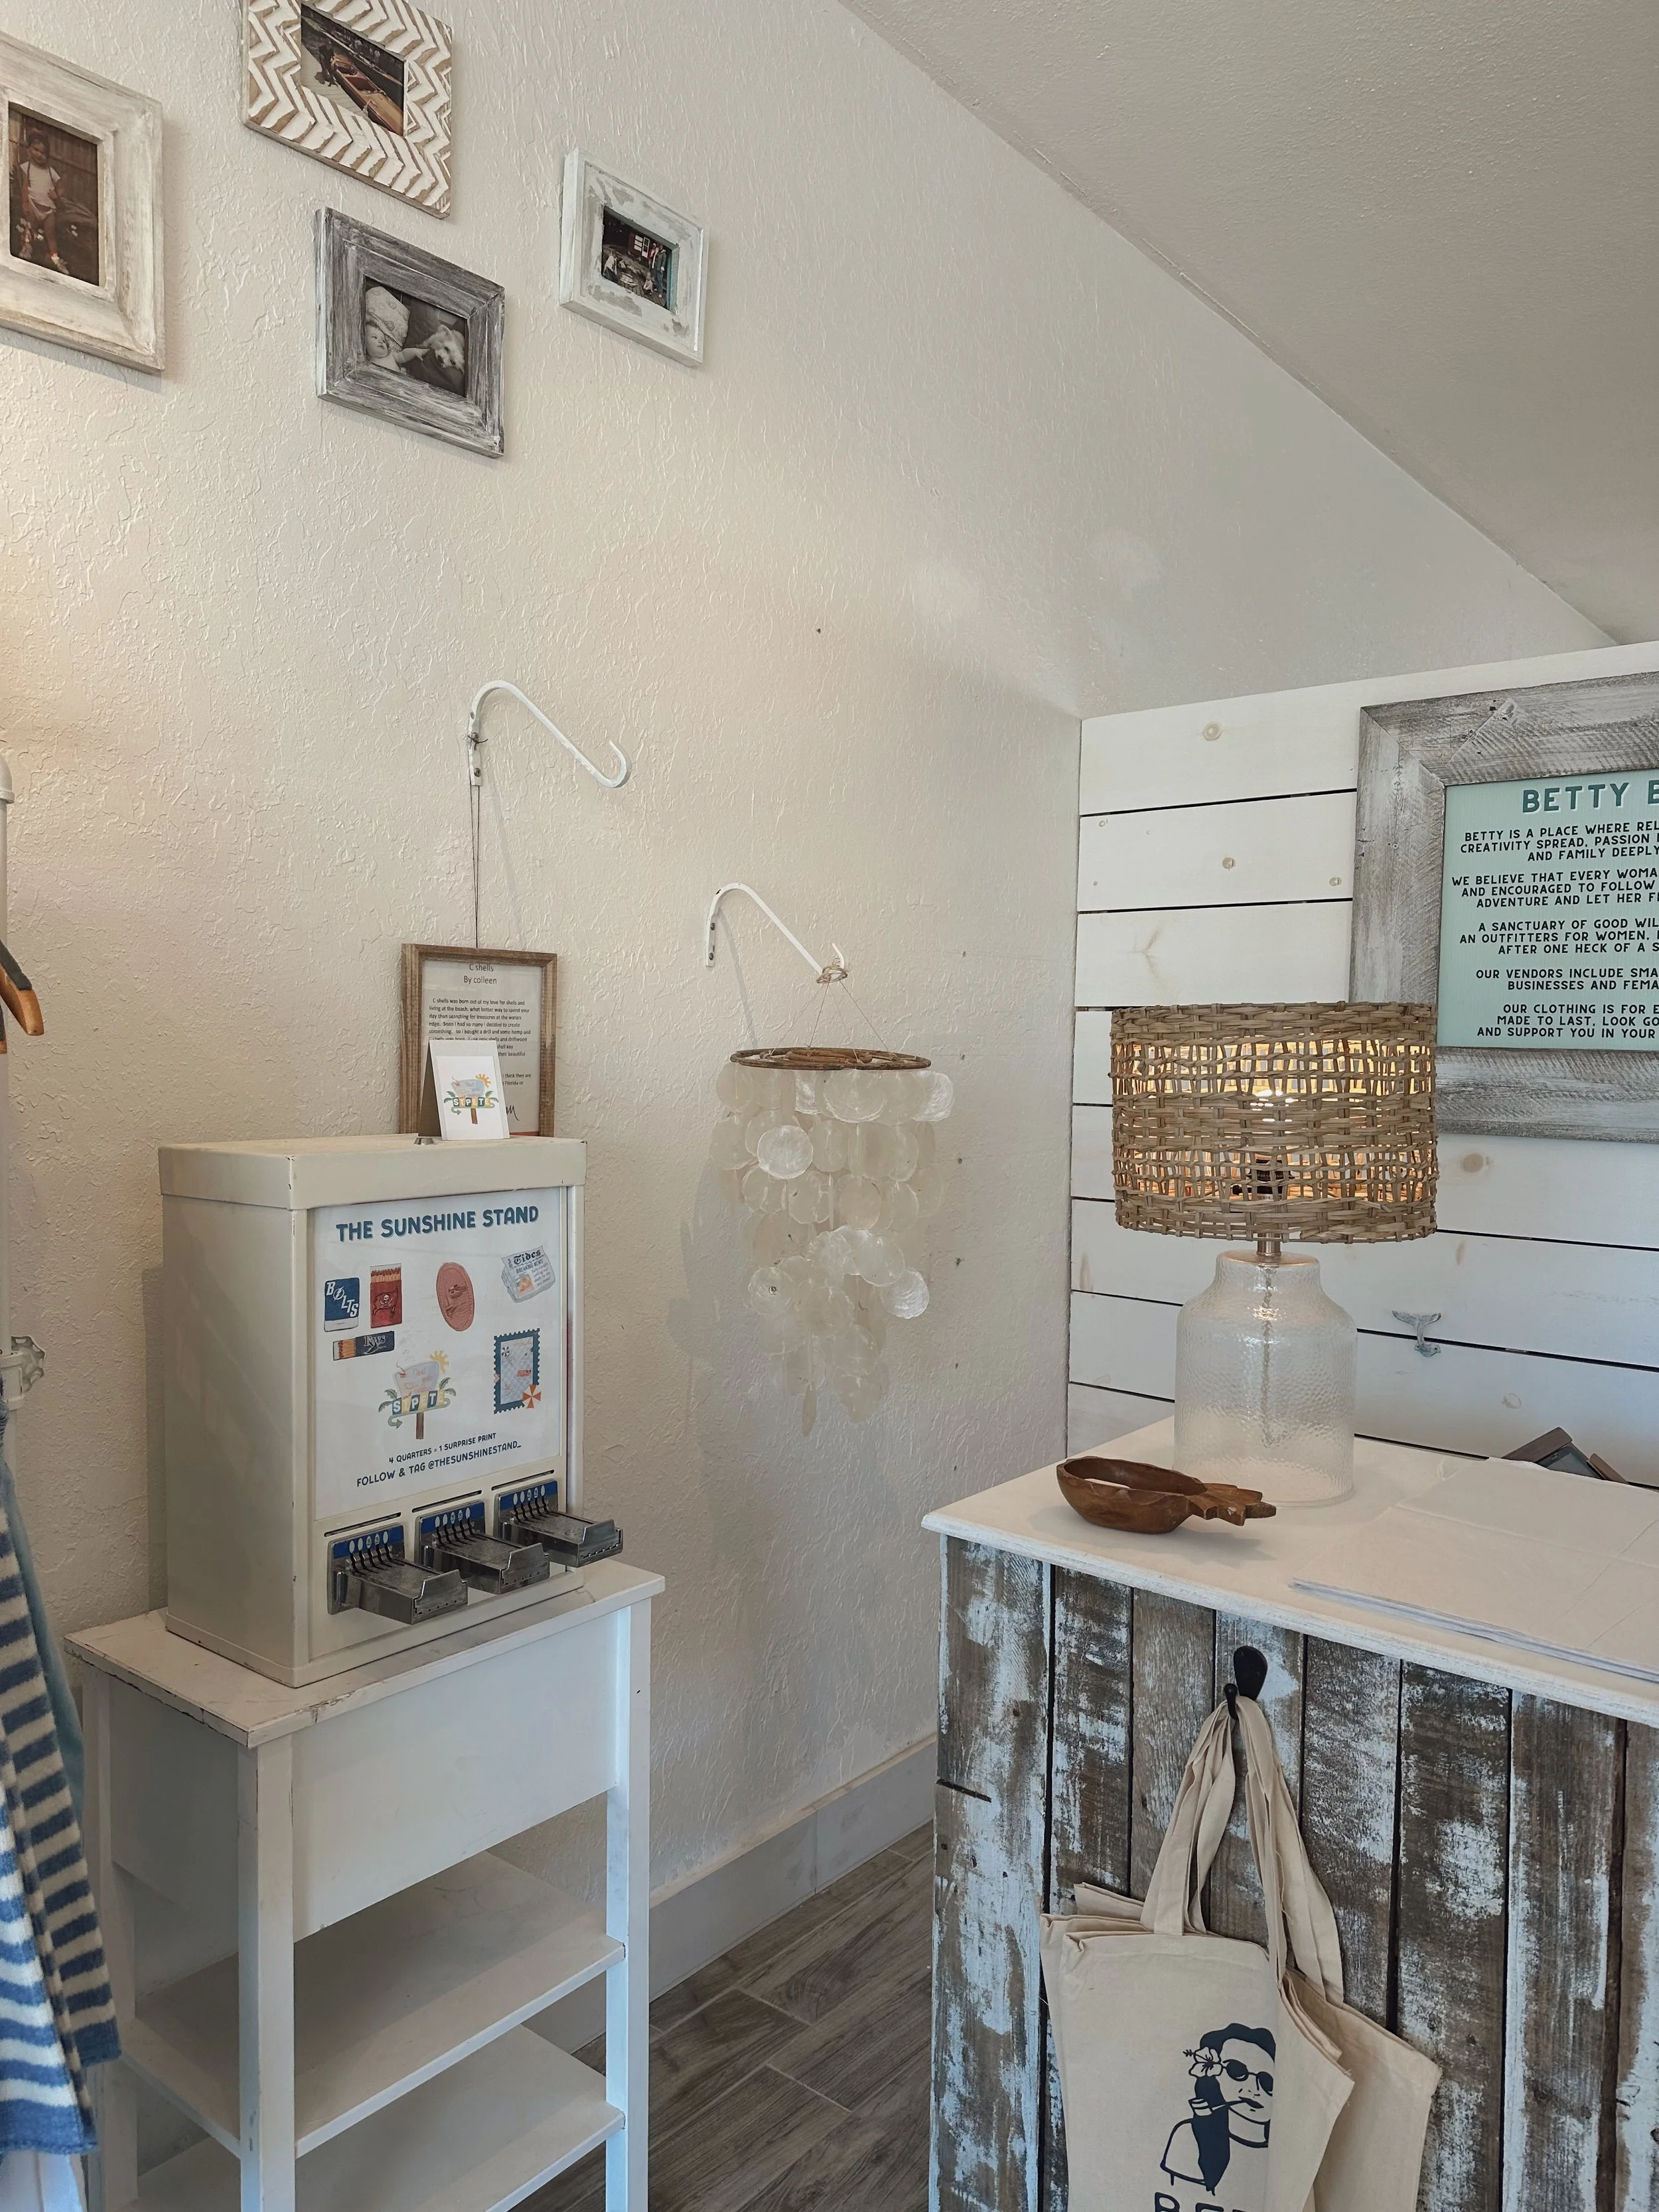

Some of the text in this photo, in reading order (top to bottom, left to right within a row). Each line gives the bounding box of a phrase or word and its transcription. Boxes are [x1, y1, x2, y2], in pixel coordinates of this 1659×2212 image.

[1522, 782, 1629, 813] BETTY
[1465, 830, 1504, 842] BETTY
[1509, 829, 1520, 839] IS
[1526, 828, 1534, 838] A
[1540, 825, 1579, 838] PLACE
[1585, 822, 1630, 835] WHERE
[1460, 840, 1531, 853] CREATIVITY
[1536, 837, 1588, 849] SPREAD,
[1595, 833, 1650, 846] PASSION
[1527, 851, 1553, 861] AND
[1558, 848, 1606, 860] FAMILY
[1451, 876, 1470, 886] WE
[1475, 873, 1524, 885] BELIEVE
[1531, 871, 1563, 883] THAT
[1570, 869, 1611, 881] EVERY
[1461, 879, 1656, 897] AND ENCOURAGED TO FOLLOW
[1476, 896, 1549, 908] ADVENTURE
[1554, 895, 1580, 905] AND
[1586, 893, 1611, 905] LET
[1617, 893, 1642, 903] HER
[1478, 922, 1486, 932] A
[1492, 920, 1565, 932] SANCTUARY
[1571, 919, 1587, 930] OF
[1593, 919, 1628, 929] GOOD
[1459, 934, 1476, 944] AN
[1481, 932, 1559, 943] OUTFITTERS
[1565, 931, 1589, 942] FOR
[1595, 930, 1650, 941] WOMEN,
[1498, 944, 1538, 955] AFTER
[1543, 944, 1569, 954] ONE
[1575, 943, 1607, 954] HECK
[1614, 942, 1630, 952] OF
[1636, 942, 1646, 952] A
[475, 963, 494, 972] shells
[1476, 969, 1500, 979] OUR
[1506, 968, 1563, 979] VENDORS
[1569, 968, 1624, 978] INCLUDE
[464, 976, 472, 984] By
[1508, 980, 1585, 990] BUSINESSES
[1590, 980, 1617, 990] AND
[1503, 1003, 1528, 1013] OUR
[1533, 1003, 1596, 1014] CLOTHING
[1603, 1004, 1615, 1014] IS
[1621, 1004, 1646, 1014] FOR
[1497, 1015, 1531, 1025] MADE
[1537, 1015, 1553, 1025] TO
[1559, 1015, 1595, 1027] LAST,
[1602, 1016, 1636, 1027] LOOK
[1477, 1027, 1656, 1039] AND SUPPORT YOU IN YOUR
[336, 1206, 539, 1242] THE SUNSHINE STAND
[513, 1250, 541, 1265] Tides
[396, 1447, 432, 1463] QUARTERS
[444, 1437, 476, 1451] SURPRISE
[478, 1433, 496, 1443] PRINT
[356, 1441, 522, 1487] FOLLOW & TAG @THESUNSHINESTAND_
